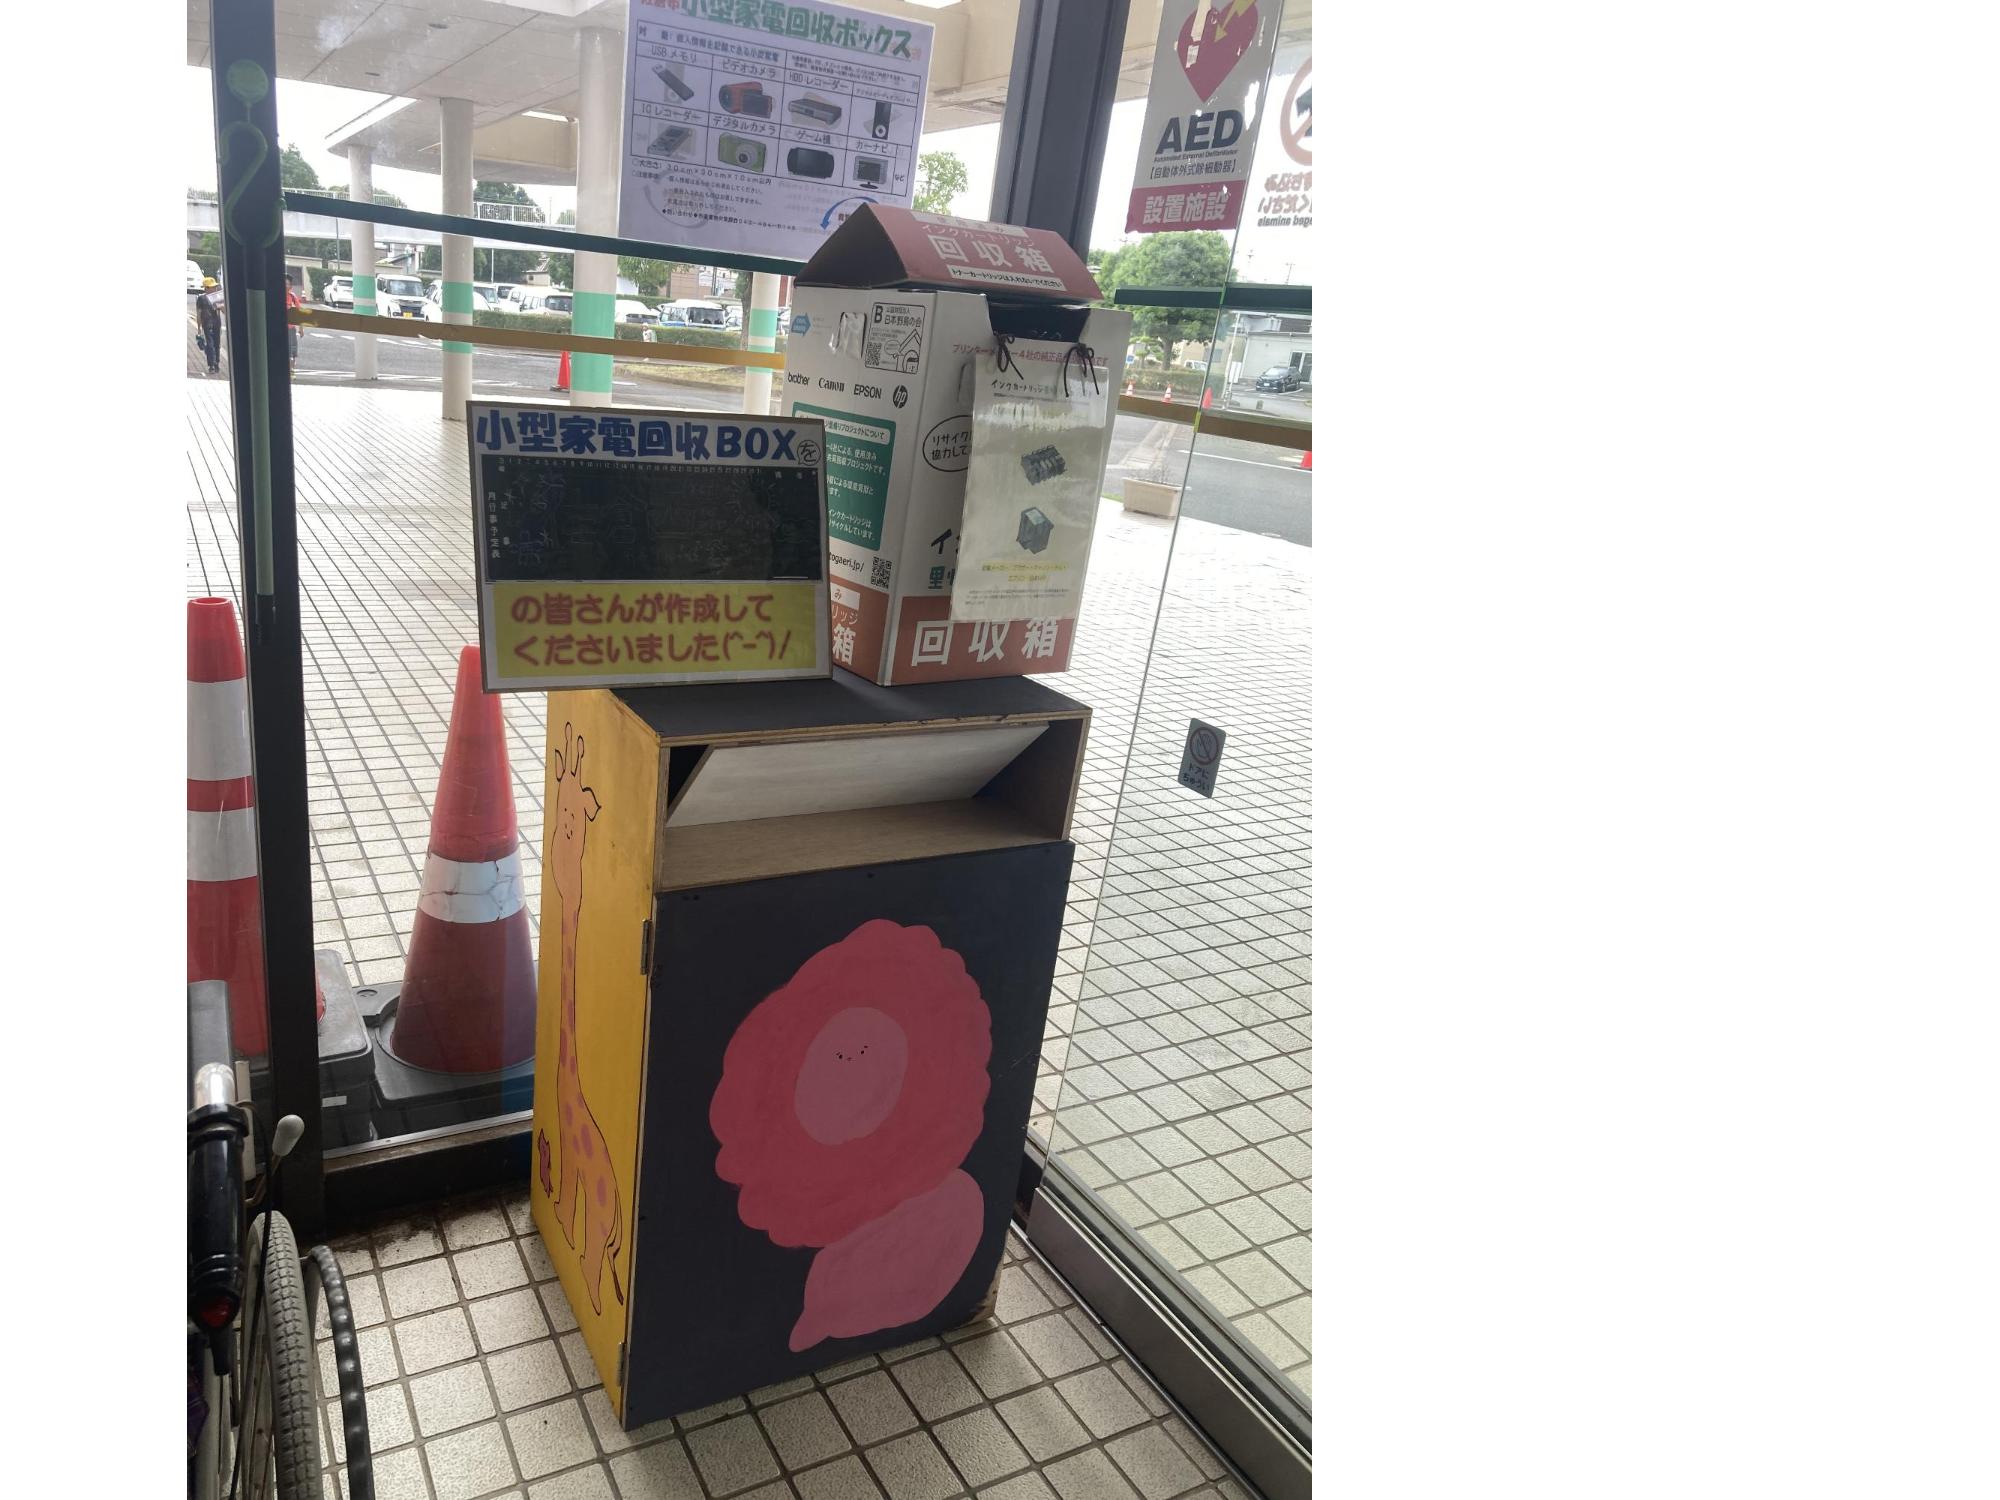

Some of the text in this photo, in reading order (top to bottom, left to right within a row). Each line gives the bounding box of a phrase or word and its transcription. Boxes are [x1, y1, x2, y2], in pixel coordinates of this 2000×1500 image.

[681, 0, 912, 58] 小型家電回収ボックス
[651, 45, 697, 64] USB メモリ
[721, 59, 776, 79] ビデオカメラ
[789, 71, 850, 90] HDD レコーダー
[654, 105, 702, 121] レコーダー
[712, 115, 776, 136] デジタルカメラ
[1155, 109, 1244, 155] AED
[797, 130, 831, 145] ゲーム機
[855, 141, 889, 153] カーナビ
[1142, 190, 1229, 225] 設置施設
[922, 223, 1036, 247] インクカートリッジ
[927, 233, 1055, 274] 回収箱
[884, 314, 922, 328] 日本野鳥の会
[787, 371, 811, 386] brother
[818, 377, 845, 393] Canon
[853, 383, 882, 399] EPSON
[476, 409, 797, 461] 小型家電回収BOX
[511, 592, 774, 626] の皆さんが作成して
[832, 623, 857, 665] 箱
[911, 616, 1059, 667] 回収箱
